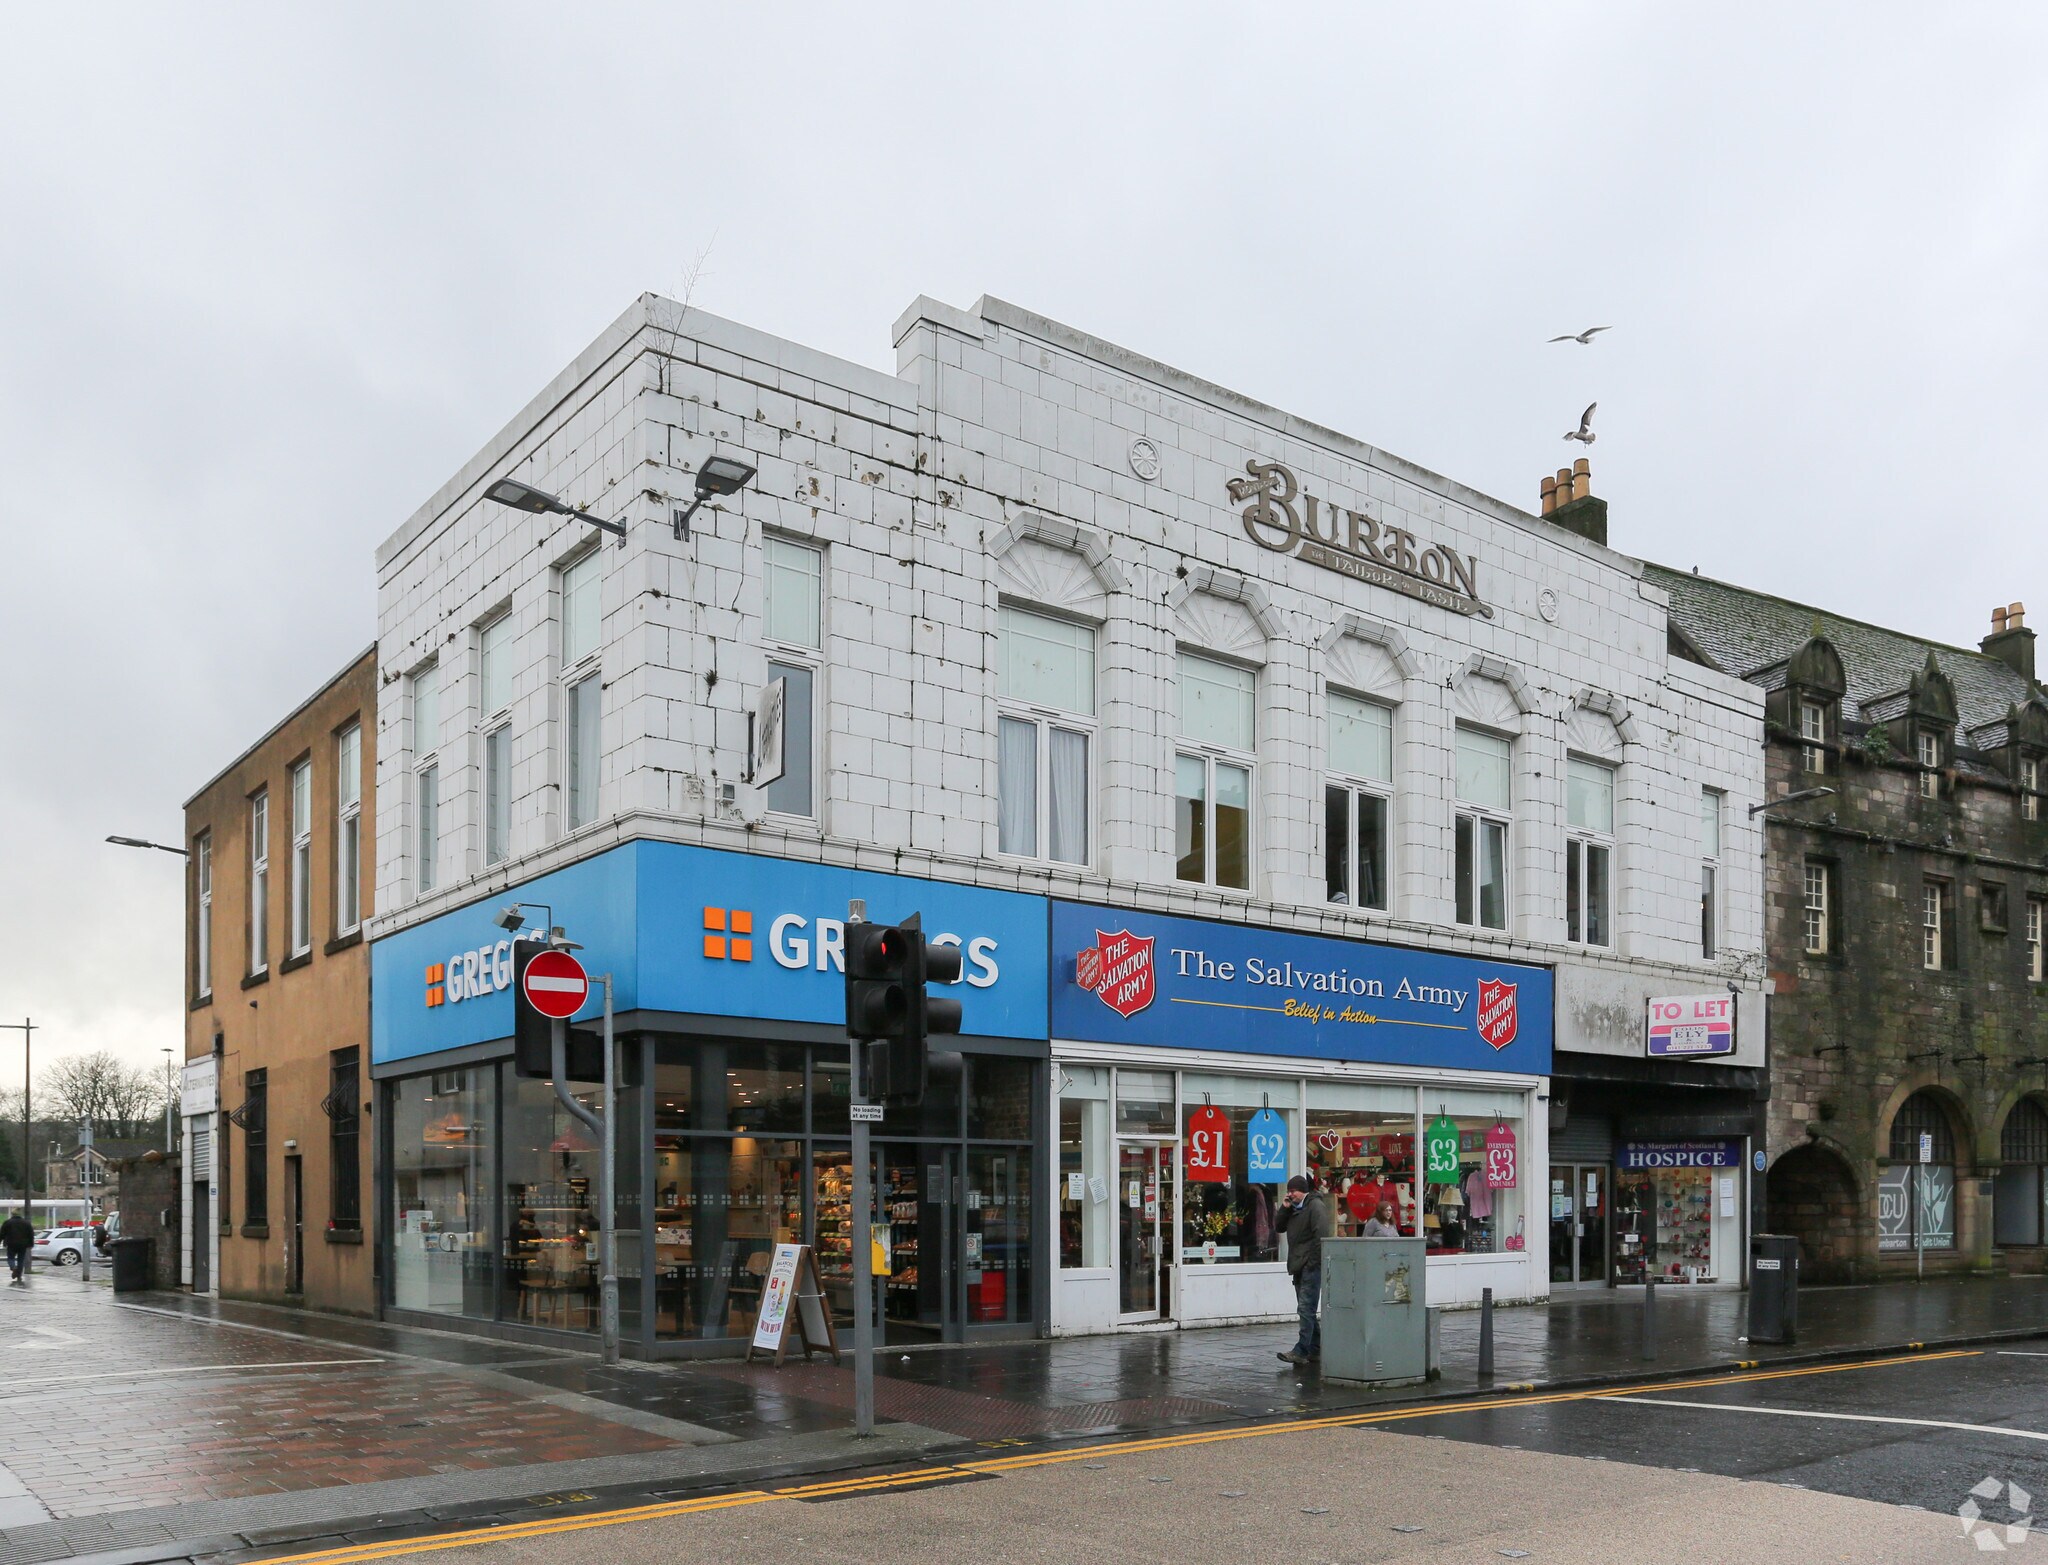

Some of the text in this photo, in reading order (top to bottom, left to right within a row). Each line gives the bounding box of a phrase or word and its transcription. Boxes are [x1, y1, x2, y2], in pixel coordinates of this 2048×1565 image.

[1243, 459, 1477, 602] BURTON
[447, 928, 547, 1003] GREG
[769, 913, 999, 988] GRS
[1105, 938, 1129, 964] THE
[1098, 945, 1149, 994] SALVATION
[1170, 948, 1469, 1013] The Salvation Army
[1117, 970, 1148, 1006] ARMY
[1483, 985, 1501, 1007] THE
[1284, 998, 1377, 1025] Belief in Action
[1479, 991, 1514, 1032] SALVATION
[1652, 1000, 1729, 1020] TO LET
[1491, 1012, 1513, 1041] ARMY
[1675, 1030, 1704, 1039] ELY
[1190, 1130, 1226, 1168] £1
[1250, 1134, 1284, 1170] £2
[1388, 1143, 1402, 1155] LOVE
[1429, 1138, 1457, 1171] £3
[1629, 1151, 1726, 1167] HOSPICE
[1649, 1143, 1678, 1151] Margaret
[1488, 1149, 1515, 1181] £3
[1933, 1237, 1950, 1247] Union
